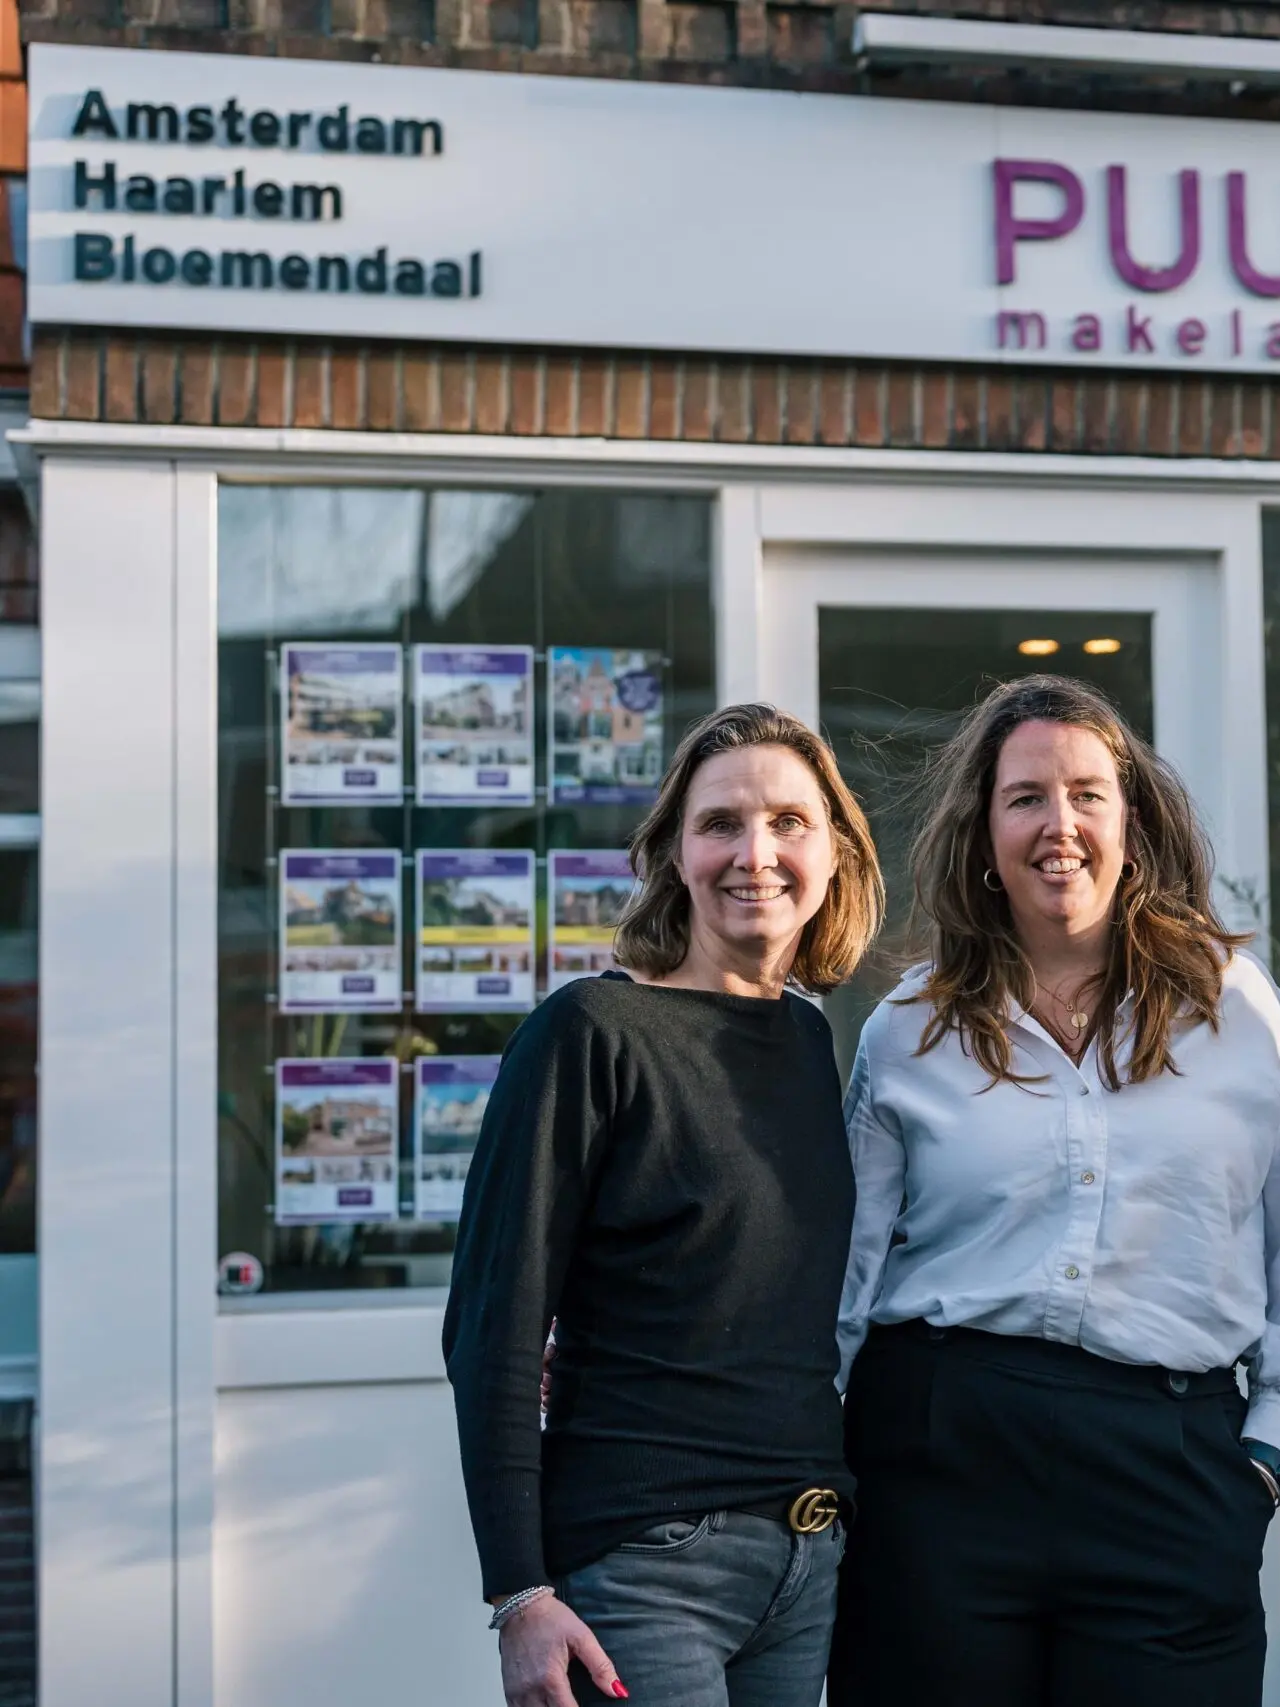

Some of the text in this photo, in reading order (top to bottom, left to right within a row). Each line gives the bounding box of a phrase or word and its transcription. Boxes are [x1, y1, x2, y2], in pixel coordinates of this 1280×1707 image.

[70, 90, 444, 157] Amsterdam
[72, 160, 343, 222] Haarlem
[72, 231, 483, 299] Bloemendaal
